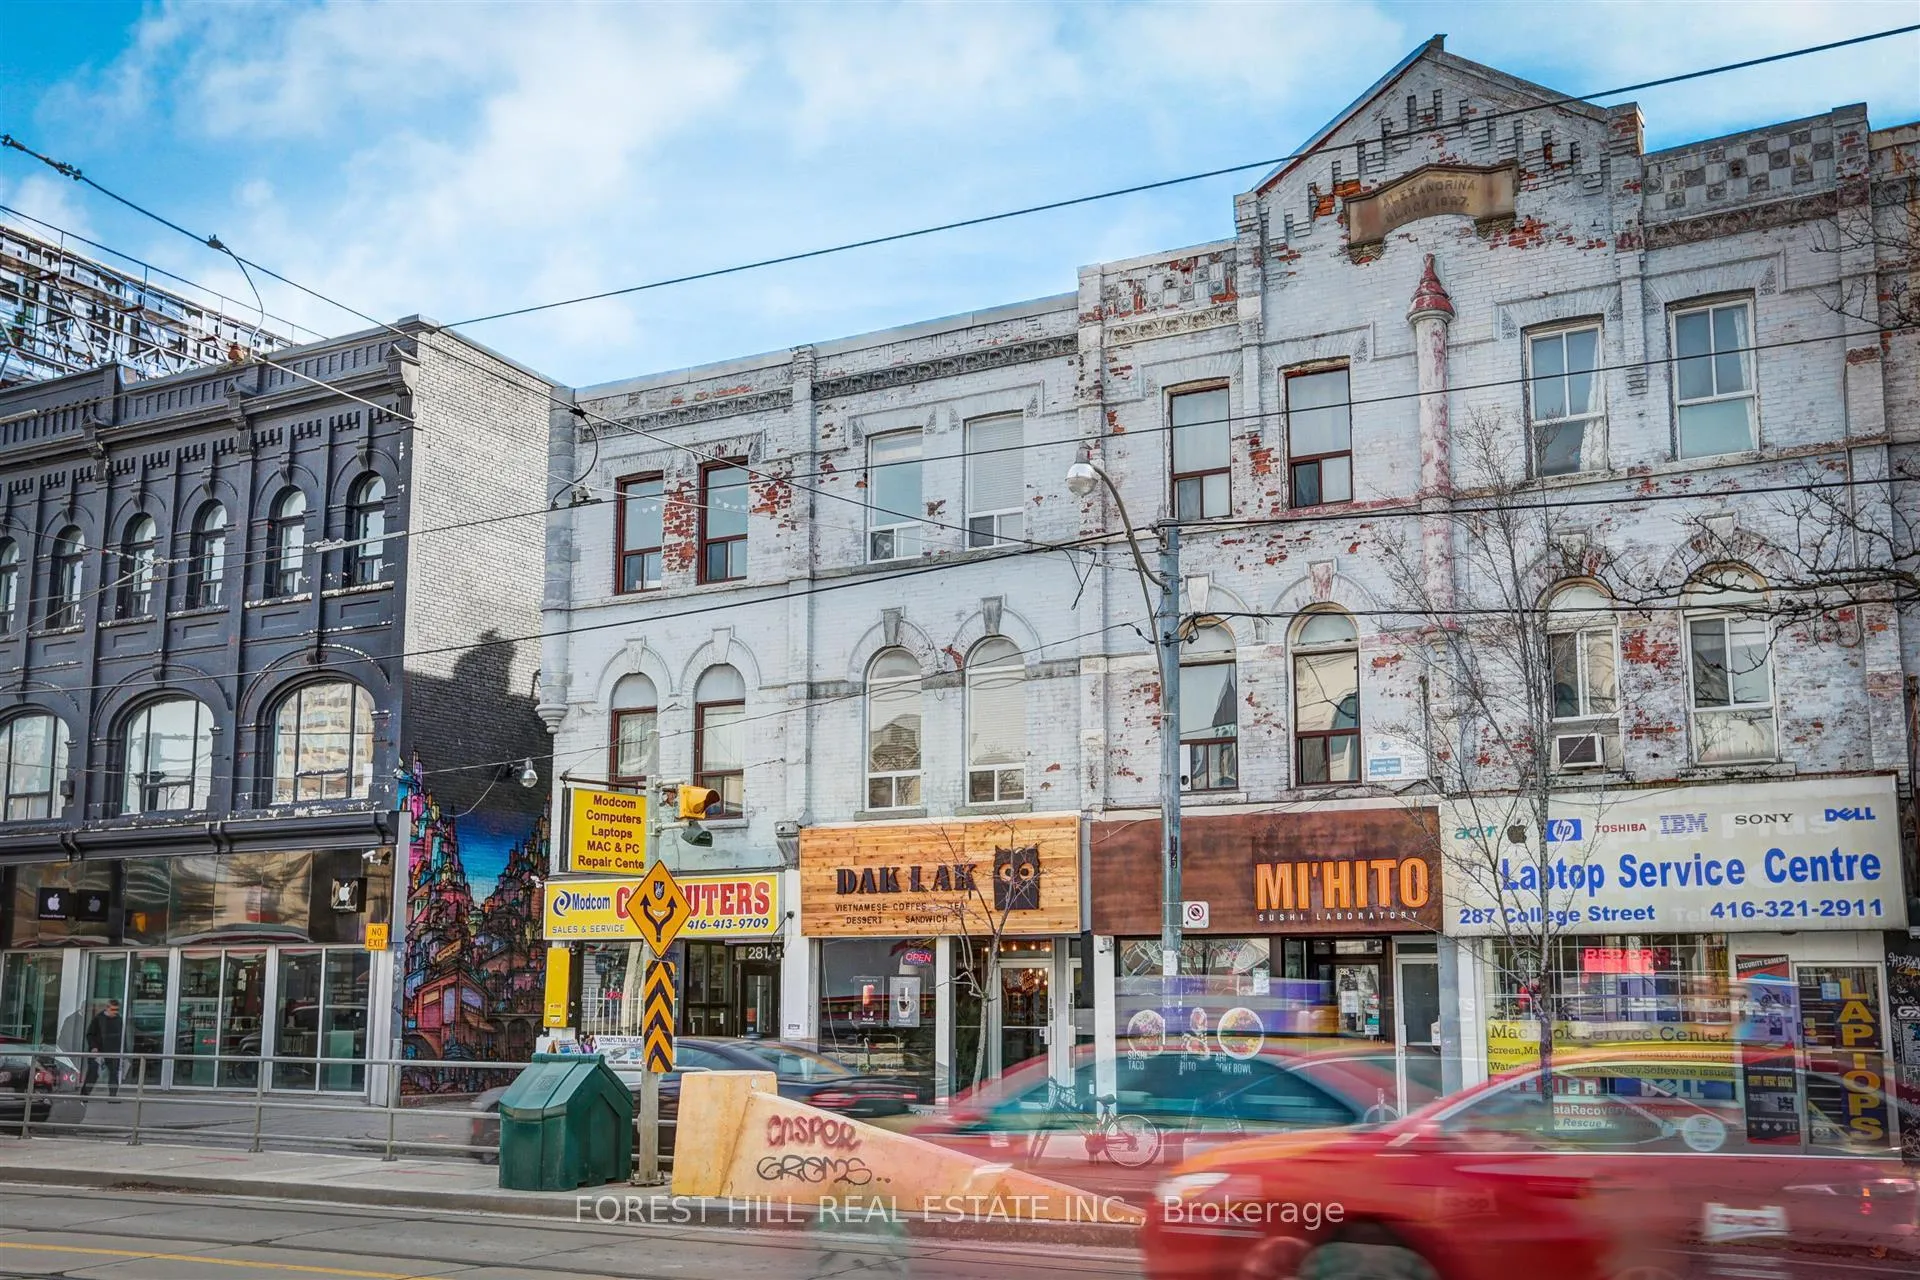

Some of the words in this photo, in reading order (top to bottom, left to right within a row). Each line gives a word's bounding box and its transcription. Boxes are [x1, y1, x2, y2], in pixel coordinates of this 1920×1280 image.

[593, 794, 636, 809] Modcom
[586, 809, 642, 825] Computers
[1455, 825, 1497, 840] acer
[1594, 823, 1648, 834] TOSHIBA
[1660, 812, 1709, 835] IBM
[1735, 813, 1794, 825] SONY
[1824, 806, 1876, 822] DELL
[591, 825, 633, 839] Laptops
[587, 840, 611, 852] MAC
[615, 842, 622, 853] &
[625, 843, 640, 854] PC
[578, 855, 613, 869] Repair
[1618, 852, 1746, 889] Service
[1764, 846, 1881, 884] Centre
[836, 866, 901, 895] DAK
[911, 863, 978, 893] LAK
[1256, 857, 1429, 911] MI'HITO
[572, 893, 610, 911] Modcom
[616, 881, 770, 919] CUTERS
[835, 903, 888, 912] VIETNAMESE
[1710, 898, 1882, 918] 416-321-2911
[846, 916, 882, 925] DESSERT
[905, 914, 948, 924] SANDWICH
[1258, 913, 1305, 922] SUSHI
[1316, 911, 1418, 921] LABORATORY
[1460, 908, 1495, 924] 287
[1504, 905, 1581, 927] College
[1588, 904, 1655, 921] Street
[552, 925, 578, 934] SALES
[581, 925, 587, 933] &
[590, 924, 625, 933] SERVICE
[687, 917, 769, 930] 416-413-9709
[371, 927, 382, 936] NO
[368, 938, 384, 948] EXIT
[905, 953, 932, 962] OPEN
[1737, 959, 1763, 969] SECURITY
[1490, 1024, 1577, 1041] Macbok
[1660, 1026, 1729, 1042] Center
[1128, 1061, 1145, 1070] TACO
